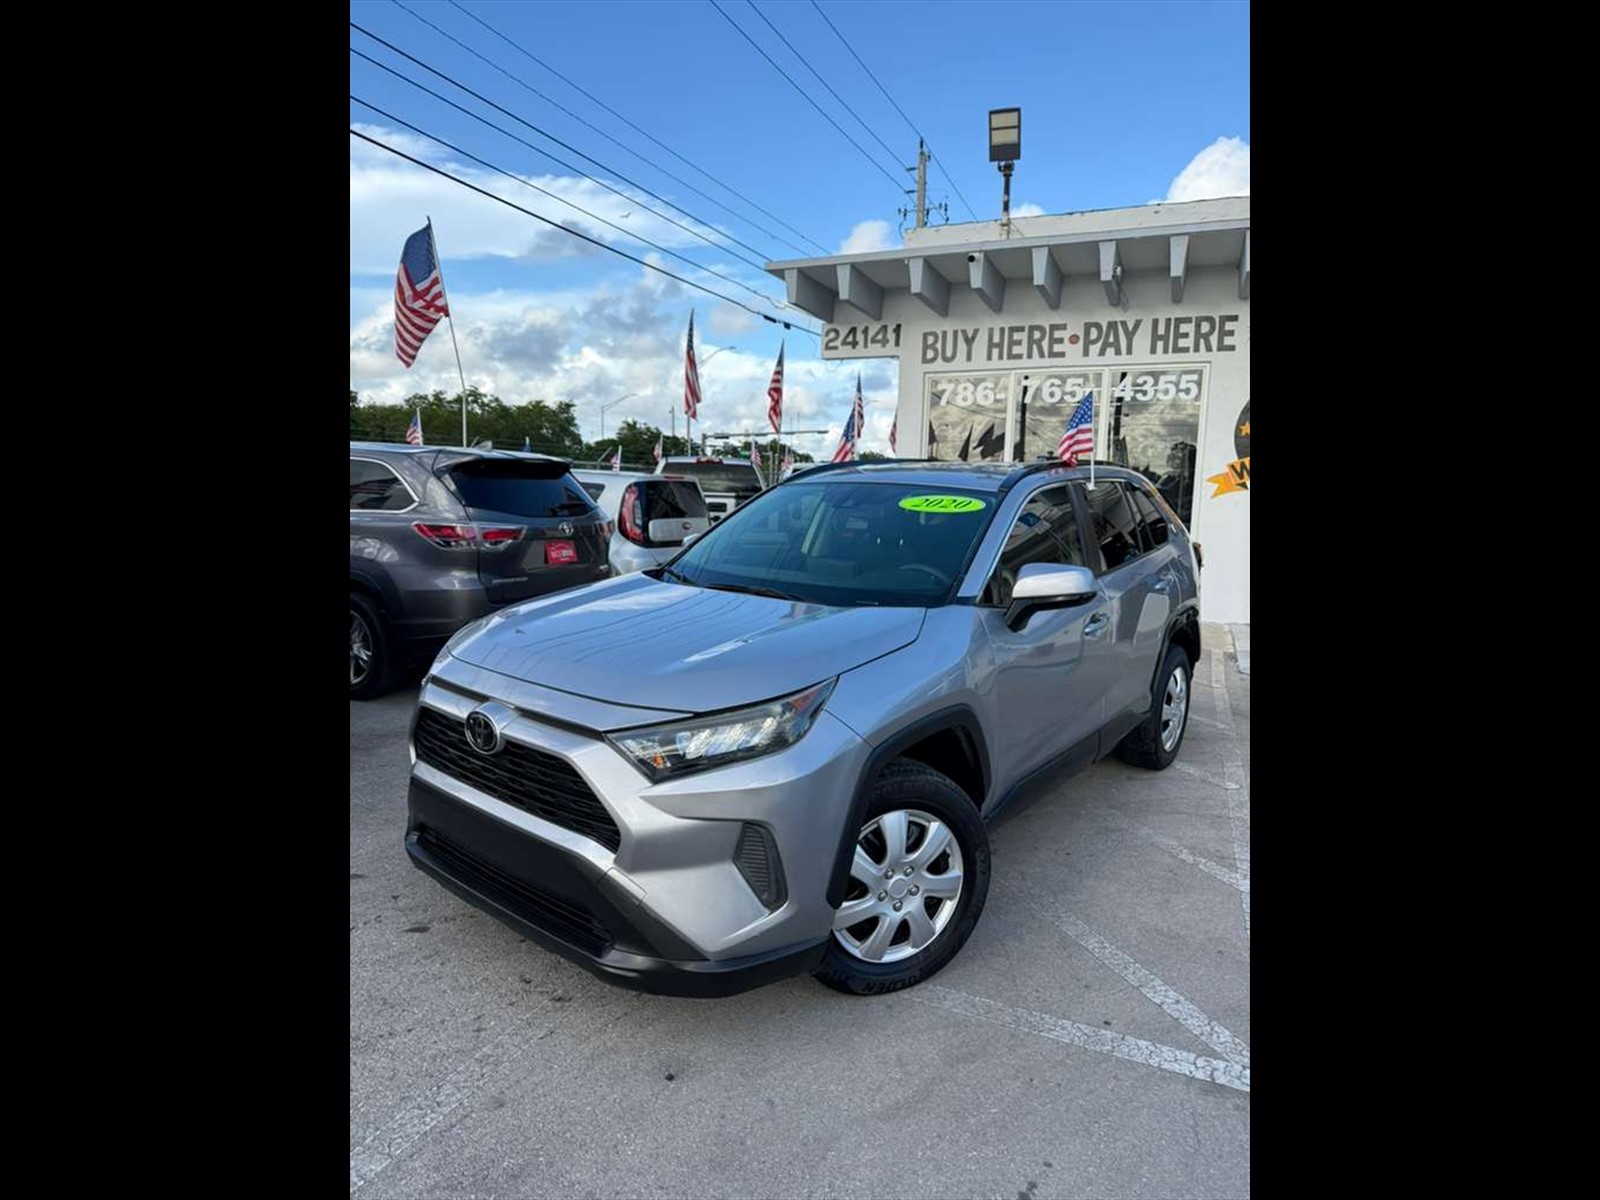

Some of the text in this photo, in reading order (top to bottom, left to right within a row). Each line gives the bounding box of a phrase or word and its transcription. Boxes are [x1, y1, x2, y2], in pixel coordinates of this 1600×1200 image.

[824, 323, 902, 351] 24141
[921, 314, 1239, 364] BUY HERE PAY HERE
[937, 380, 1006, 407] 786-
[1114, 374, 1199, 402] 4355
[911, 498, 973, 509] 2020
